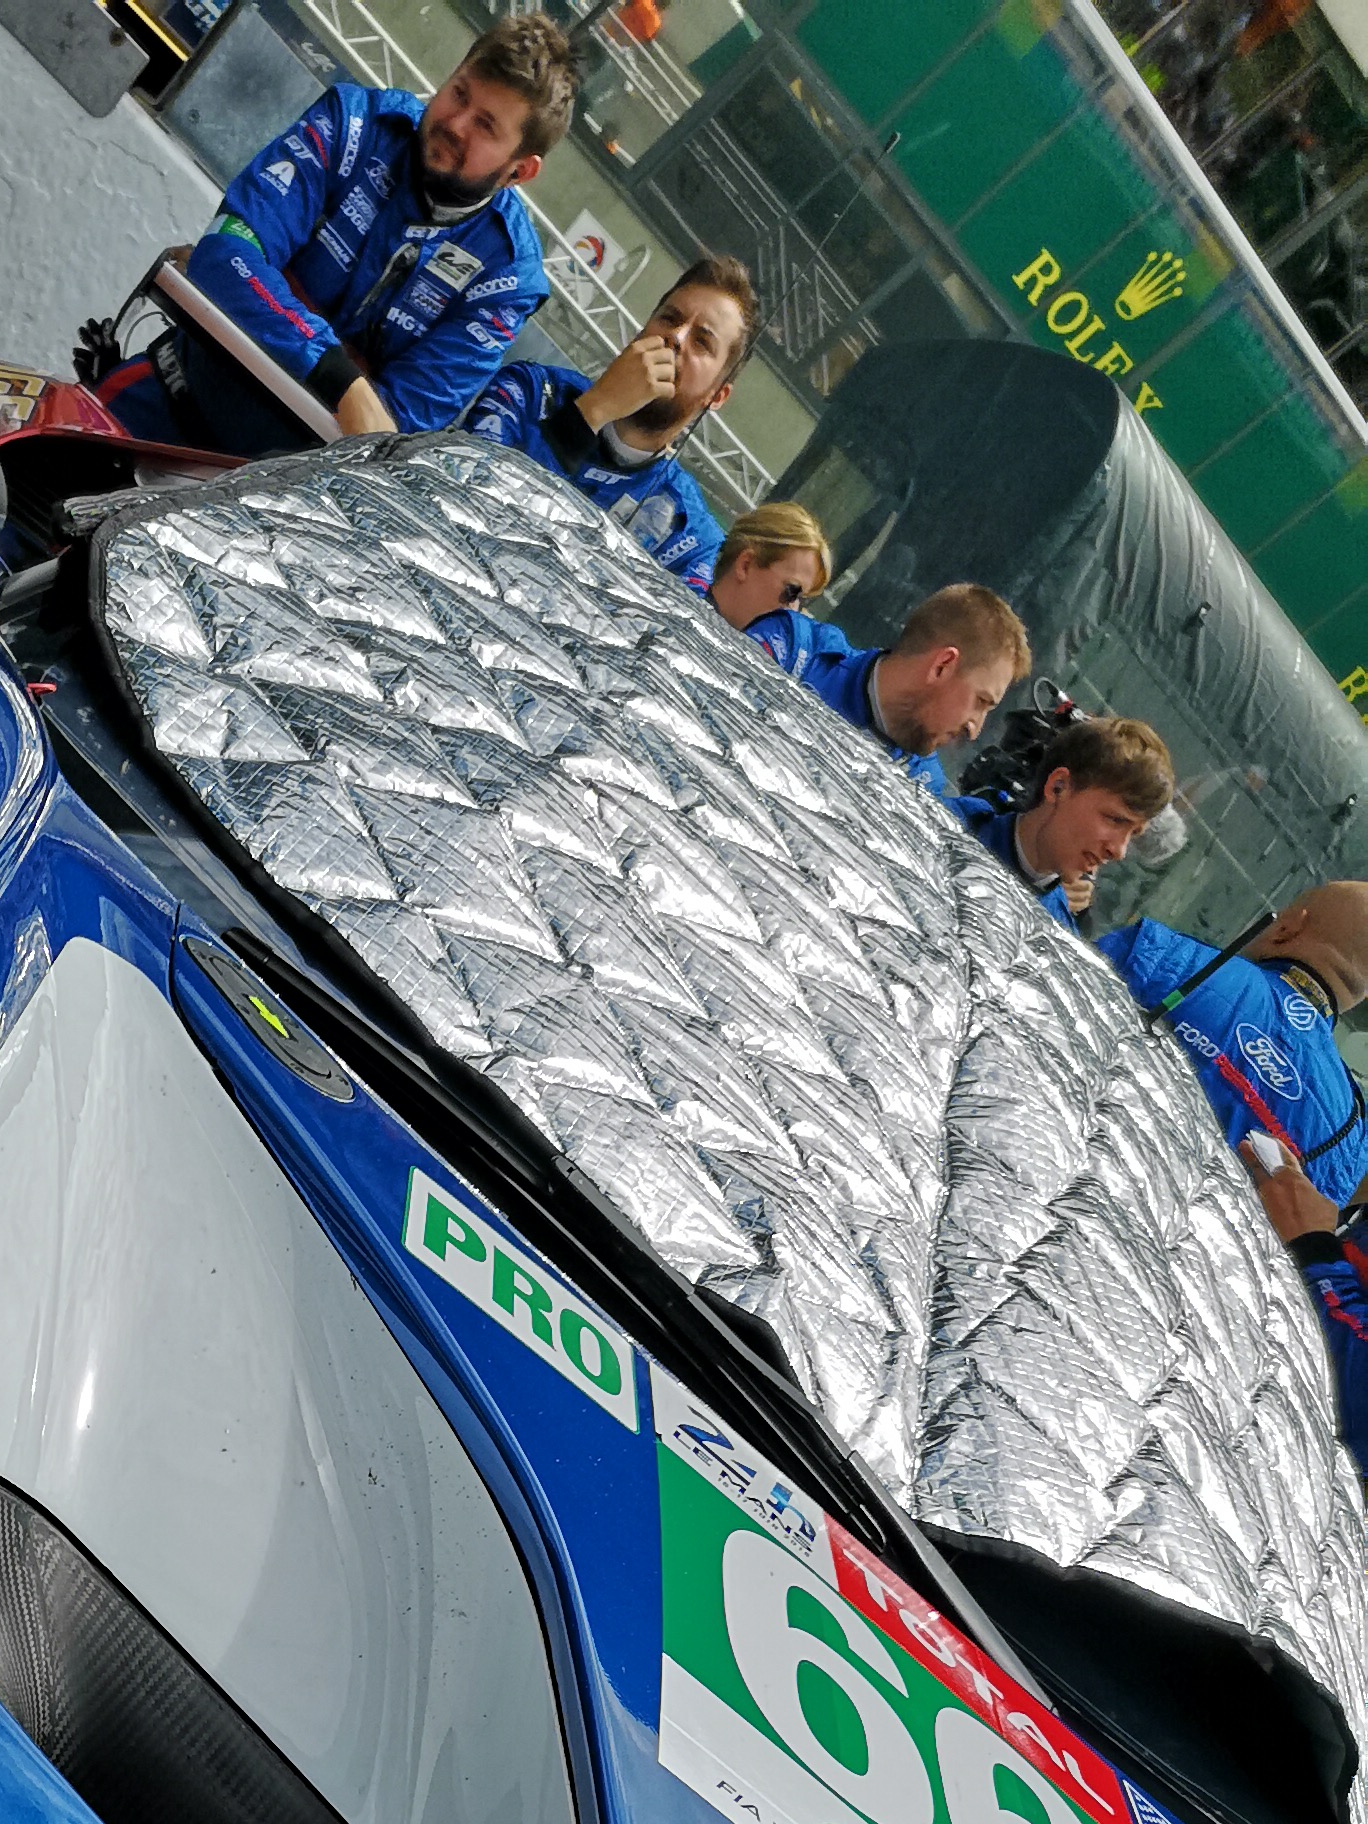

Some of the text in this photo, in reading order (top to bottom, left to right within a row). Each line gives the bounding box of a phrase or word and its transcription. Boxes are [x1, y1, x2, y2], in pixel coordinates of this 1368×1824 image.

[231, 256, 252, 279] ORD
[1174, 1021, 1222, 1059] FORD
[1245, 1037, 1294, 1088] Ford
[423, 1192, 622, 1397] PRO
[673, 1430, 813, 1552] LE MANS
[842, 1548, 1115, 1816] TOTAL
[716, 1780, 761, 1822] FIA
